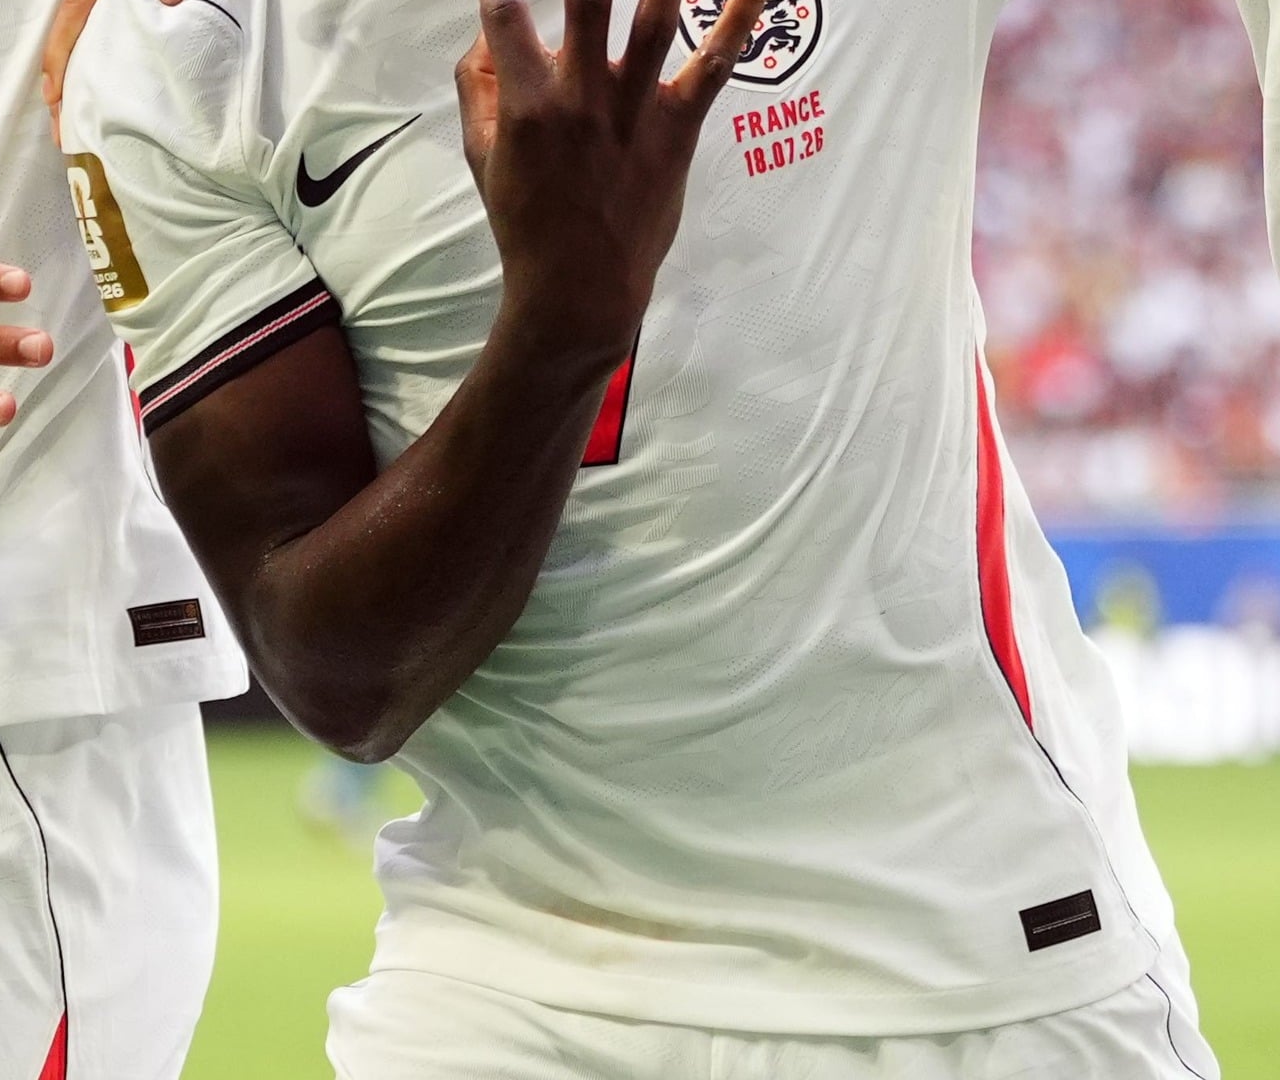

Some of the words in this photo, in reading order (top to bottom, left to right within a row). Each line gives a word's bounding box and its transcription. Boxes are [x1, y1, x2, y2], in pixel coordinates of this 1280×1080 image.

[732, 90, 825, 143] FRANCE
[744, 126, 824, 177] 18.07.26
[97, 282, 125, 300] 26
